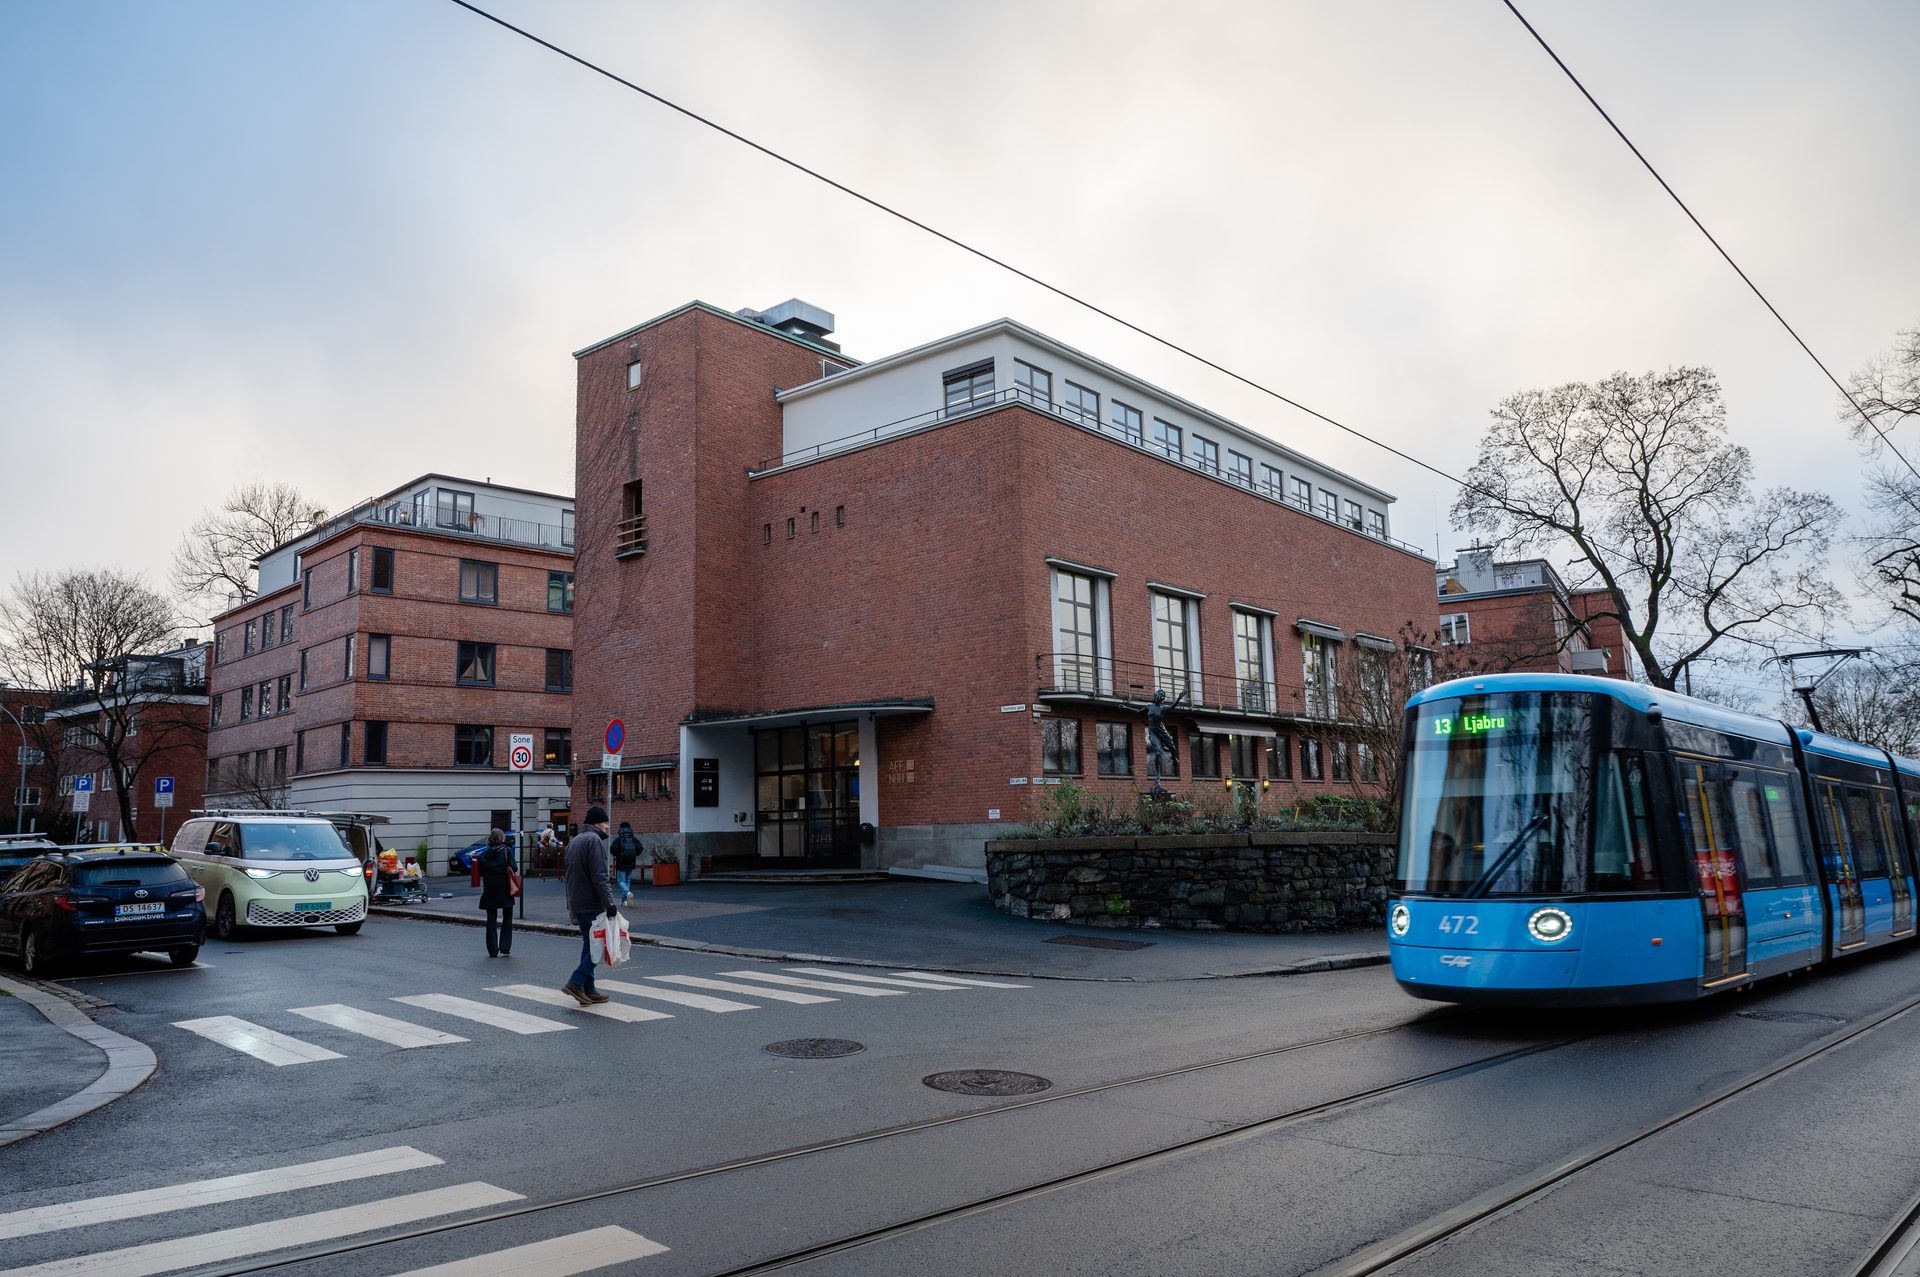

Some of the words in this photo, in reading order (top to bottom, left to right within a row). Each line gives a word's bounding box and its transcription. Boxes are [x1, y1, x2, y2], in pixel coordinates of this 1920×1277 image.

[1435, 718, 1452, 734] 13
[1464, 716, 1504, 734] Ljabru
[512, 736, 530, 744] Sone
[515, 751, 528, 763] 30
[889, 760, 904, 771] AFF
[79, 779, 88, 789] P
[888, 773, 904, 784] NHH
[160, 779, 170, 791] P
[122, 904, 134, 913] DS
[138, 902, 162, 911] 14637
[115, 912, 164, 922] bilkollektivet
[1438, 915, 1480, 935] 472
